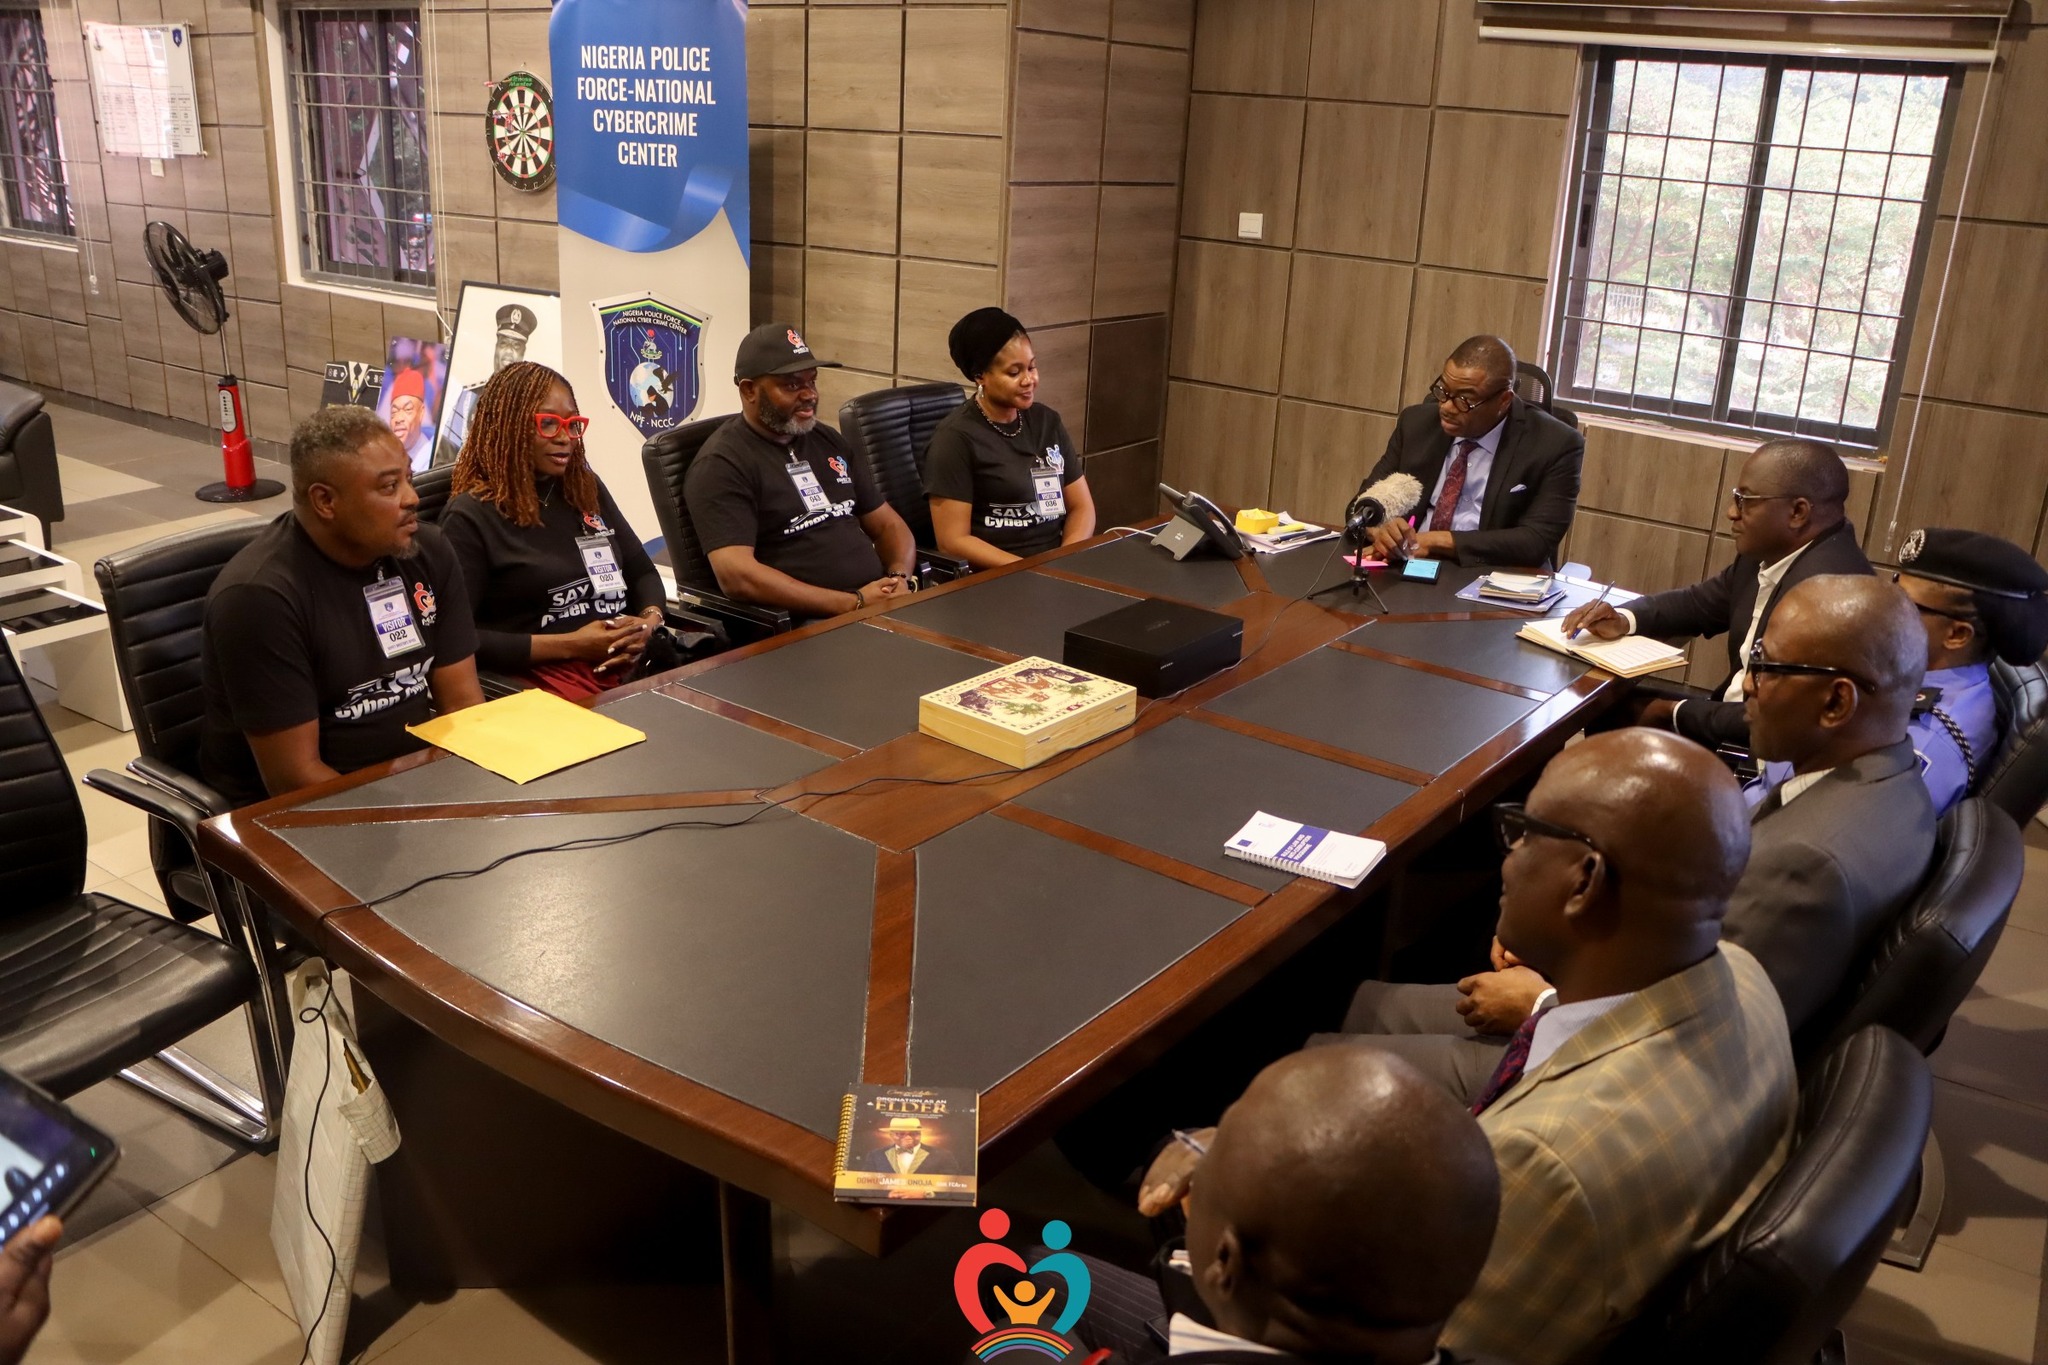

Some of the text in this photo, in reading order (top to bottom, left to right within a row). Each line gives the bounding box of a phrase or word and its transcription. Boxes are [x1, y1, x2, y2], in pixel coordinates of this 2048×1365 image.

[581, 45, 711, 72] NIGERIA POLICE
[577, 77, 716, 105] FORCE-NATIONAL
[593, 109, 698, 137] CYBERCRIME
[618, 141, 678, 168] CENTER
[613, 317, 636, 326] NATIONAL
[653, 319, 668, 327] CRIME
[669, 323, 687, 335] CENTER
[645, 311, 663, 319] POLICE
[664, 314, 681, 325] FORCE
[630, 411, 645, 425] NPF
[651, 417, 675, 428] NCCC
[984, 515, 1033, 528] Cyber
[552, 584, 590, 607] SAY
[382, 617, 408, 632] VISITOR
[389, 629, 408, 642] 022
[875, 1099, 950, 1114] ELDER
